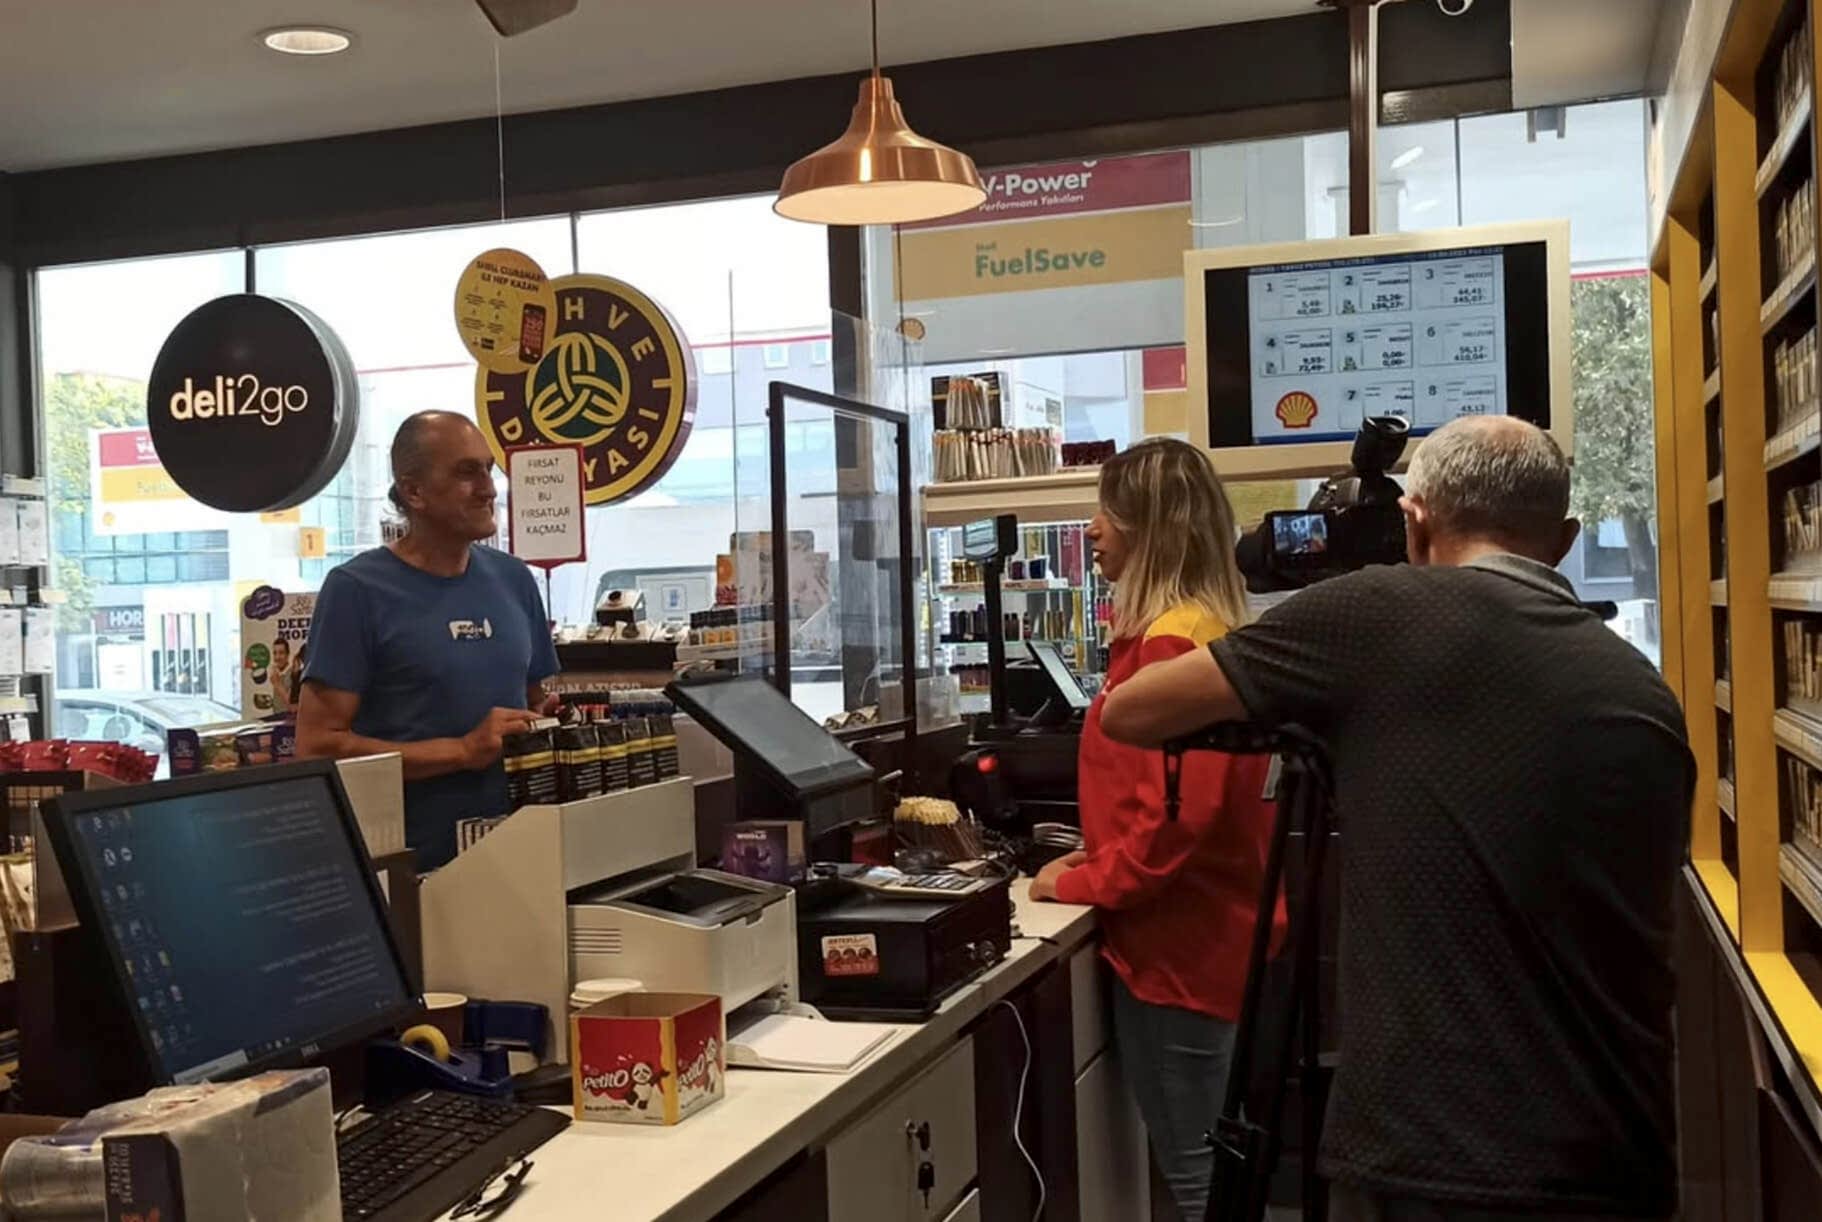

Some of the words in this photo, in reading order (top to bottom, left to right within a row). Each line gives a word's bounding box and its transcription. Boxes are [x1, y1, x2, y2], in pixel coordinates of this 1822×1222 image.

[980, 171, 1093, 196] V-Power
[976, 248, 1105, 278] FuelSave
[1425, 268, 1434, 280] 3
[1344, 275, 1353, 286] 2
[1265, 281, 1273, 293] 1
[1345, 331, 1355, 343] 5
[1427, 326, 1436, 338] 6
[1266, 337, 1276, 348] 4
[1347, 389, 1357, 401] 7
[1427, 384, 1437, 396] 8
[170, 373, 309, 426] deli2go
[528, 457, 559, 468] FIRSAT
[525, 474, 565, 485] REYONU
[538, 491, 552, 502] BU
[521, 507, 570, 518] FIRSATLAR
[526, 523, 567, 536] KAÇMAZ
